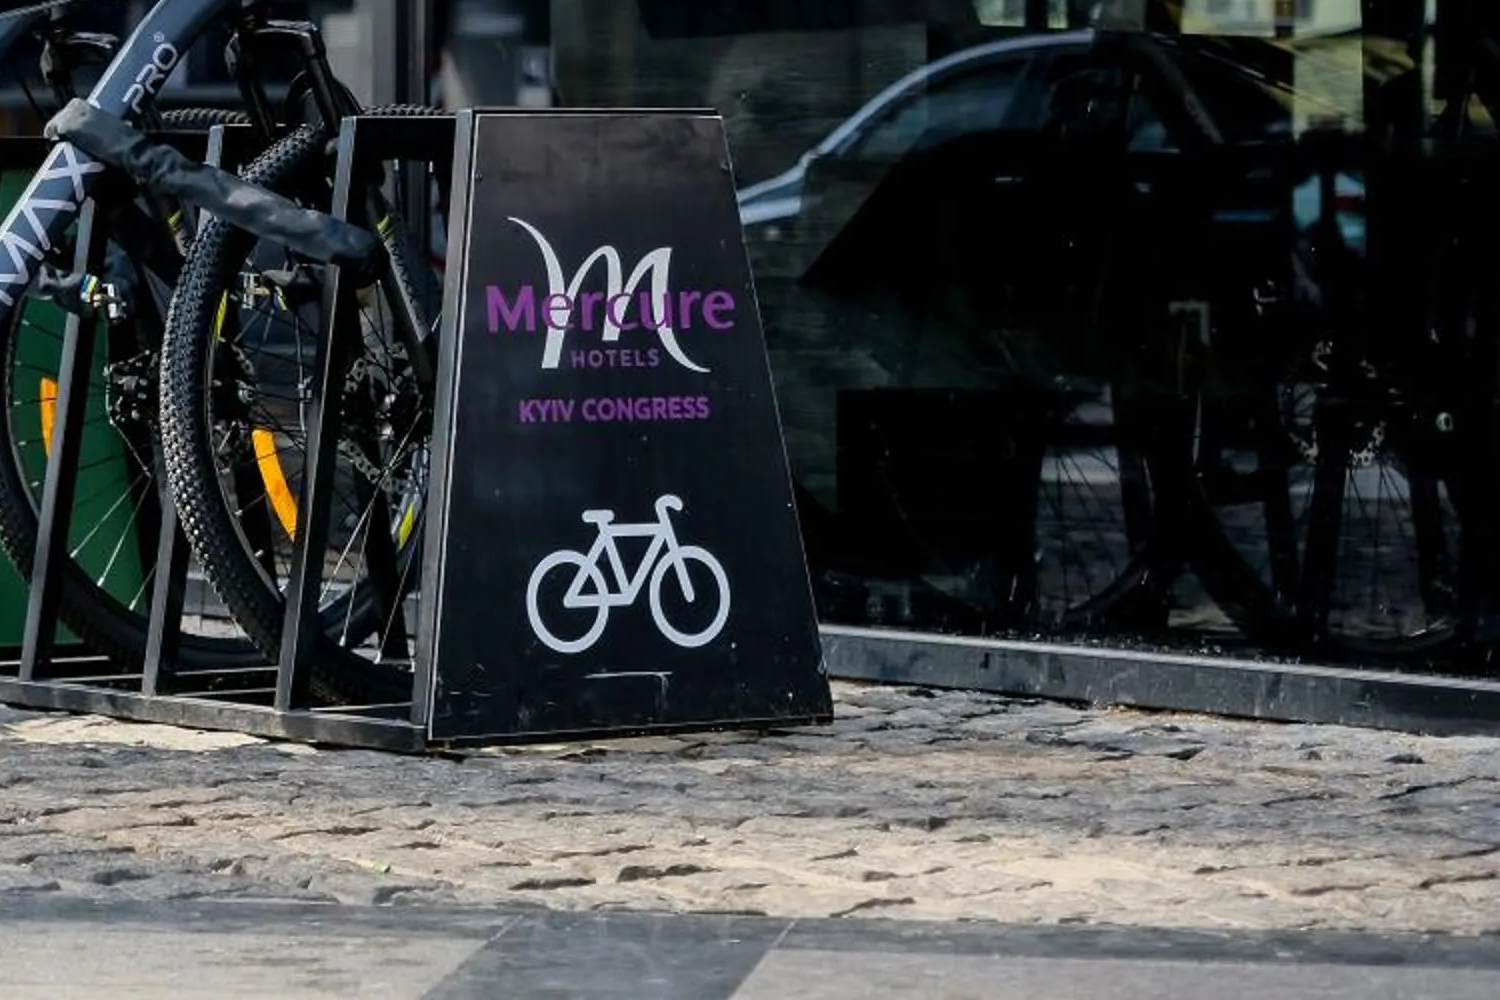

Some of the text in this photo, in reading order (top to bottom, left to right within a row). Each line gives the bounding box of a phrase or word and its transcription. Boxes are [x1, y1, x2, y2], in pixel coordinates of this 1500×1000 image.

[486, 285, 736, 333] Mercure
[571, 349, 660, 369] HOTELS
[519, 397, 710, 423] KYIV CONGRESS
